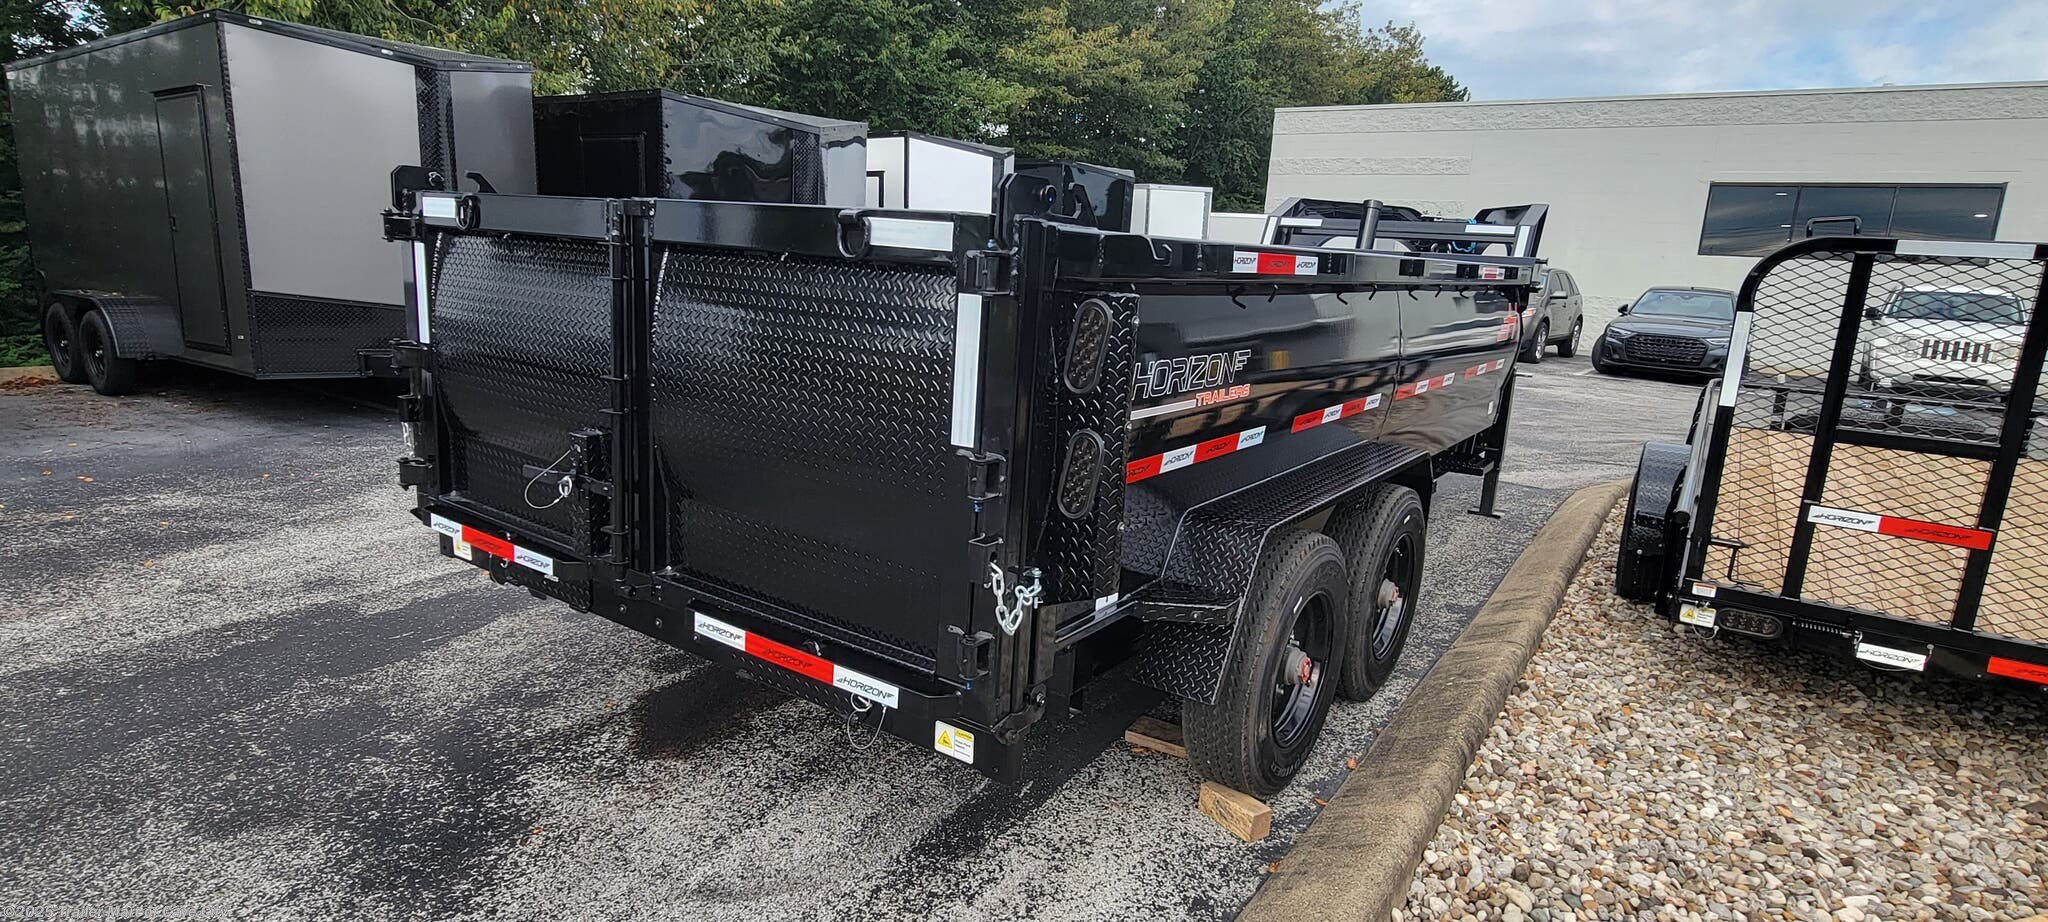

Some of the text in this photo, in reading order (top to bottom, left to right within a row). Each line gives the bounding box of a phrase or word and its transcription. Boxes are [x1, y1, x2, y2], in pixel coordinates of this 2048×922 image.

[1131, 349, 1251, 401] HORIZON
[1195, 384, 1251, 407] TRAILERS
[1812, 512, 1875, 527] HORIZON
[1906, 528, 1973, 541] HORIZON
[700, 621, 743, 641] HORIZON
[764, 648, 813, 670] HORIZON
[1858, 648, 1922, 664] HORIZON
[836, 675, 895, 700] HORIZON
